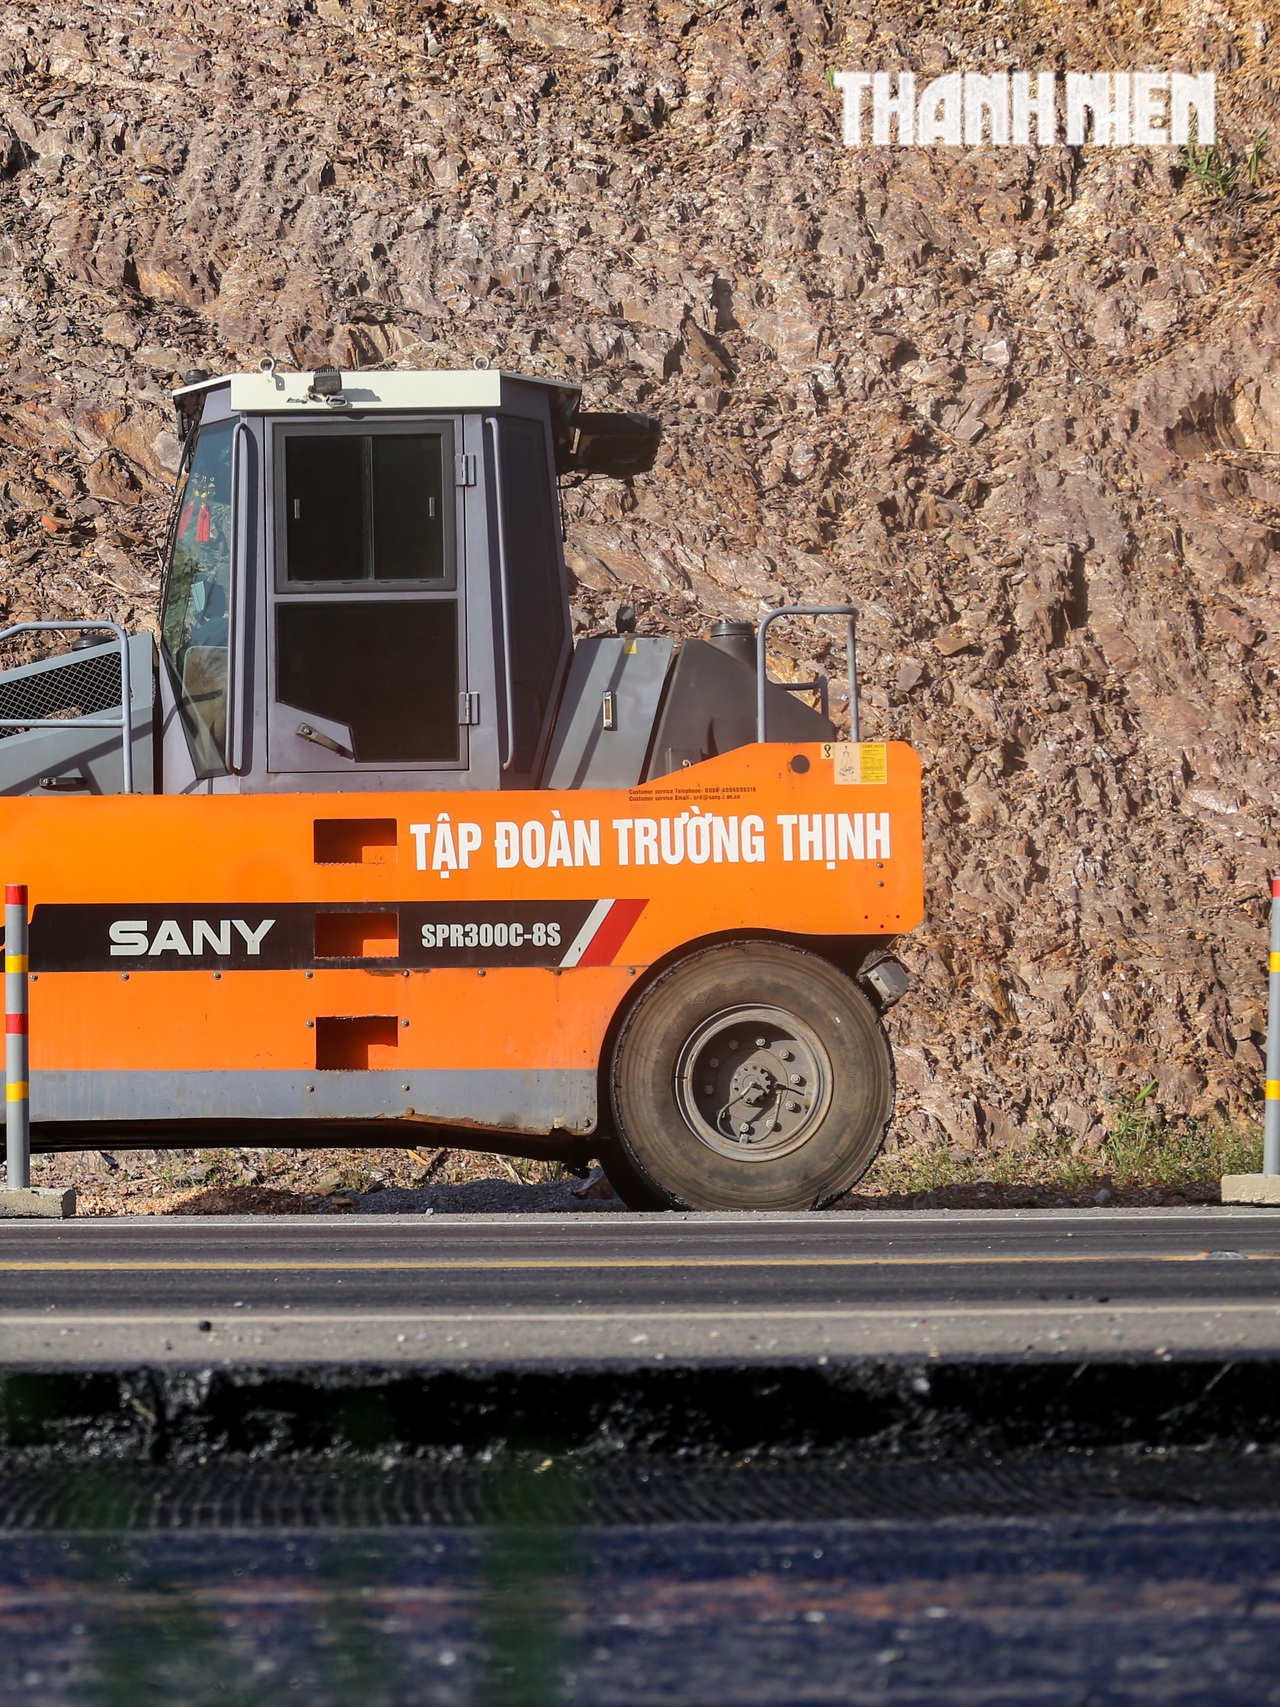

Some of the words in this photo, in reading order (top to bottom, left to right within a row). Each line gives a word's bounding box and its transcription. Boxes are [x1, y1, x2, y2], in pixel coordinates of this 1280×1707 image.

[410, 813, 483, 879] TẬP
[494, 809, 601, 869] ĐOÀN
[612, 805, 765, 867] TRƯỜNG
[776, 812, 891, 870] THỊNH
[108, 919, 276, 957] SANY
[421, 922, 562, 948] SPR300C-8S
